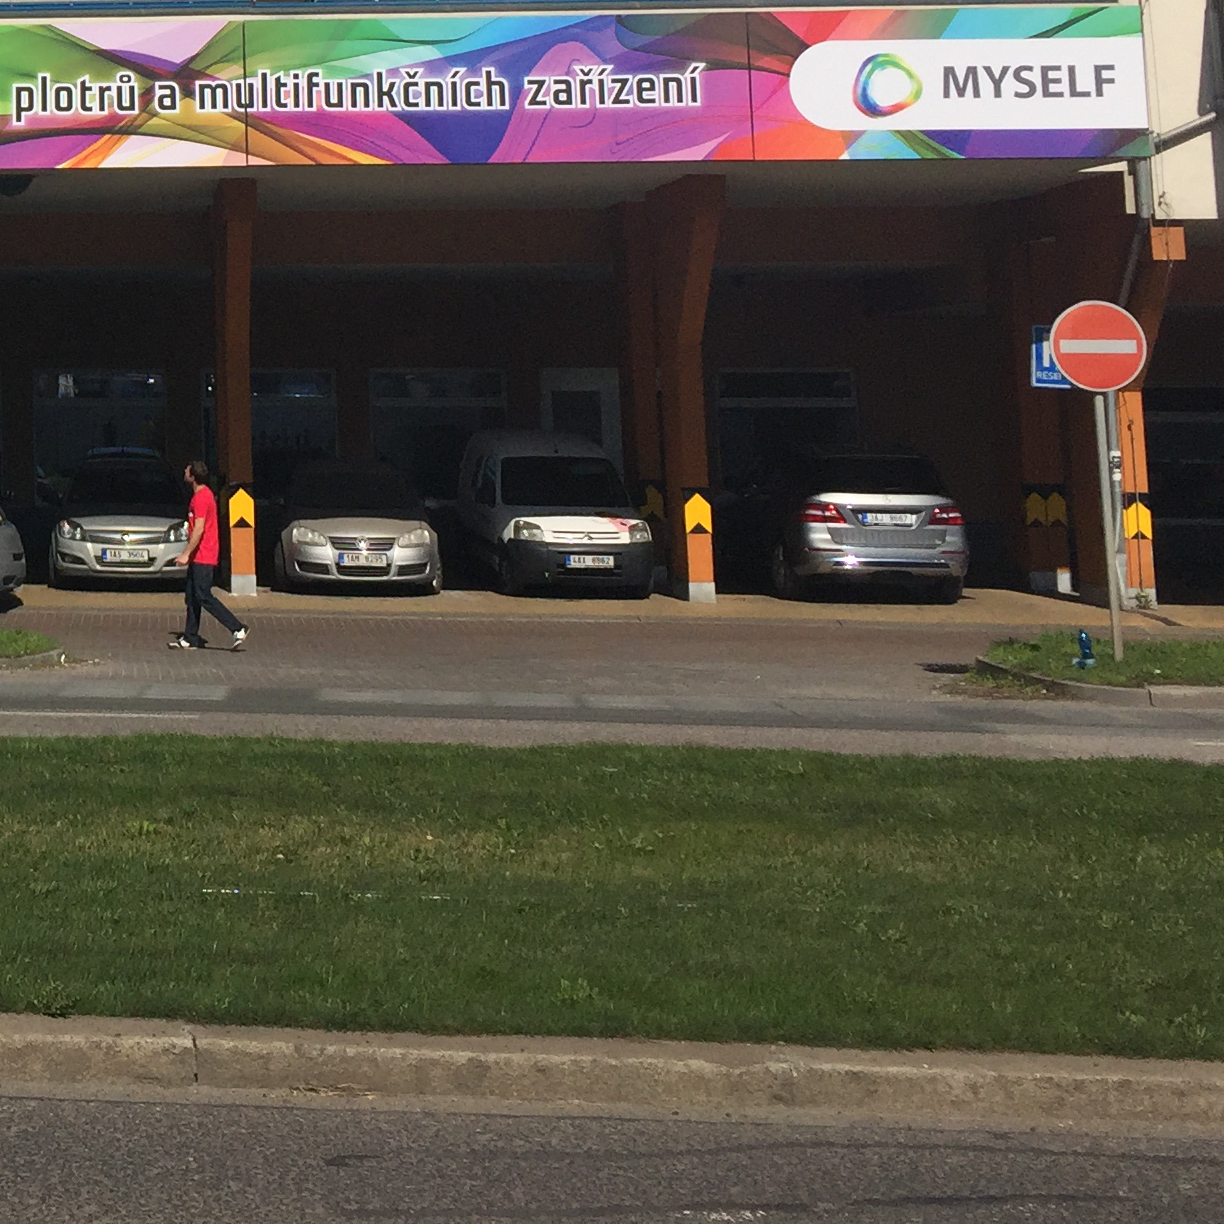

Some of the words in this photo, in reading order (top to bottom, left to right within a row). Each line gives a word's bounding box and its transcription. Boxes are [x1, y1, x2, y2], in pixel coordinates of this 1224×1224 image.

[15, 74, 136, 123] plotrů
[157, 84, 177, 111] a
[198, 70, 506, 110] multifunkčních
[527, 64, 704, 106] zařízení
[943, 64, 1116, 99] MYSELF
